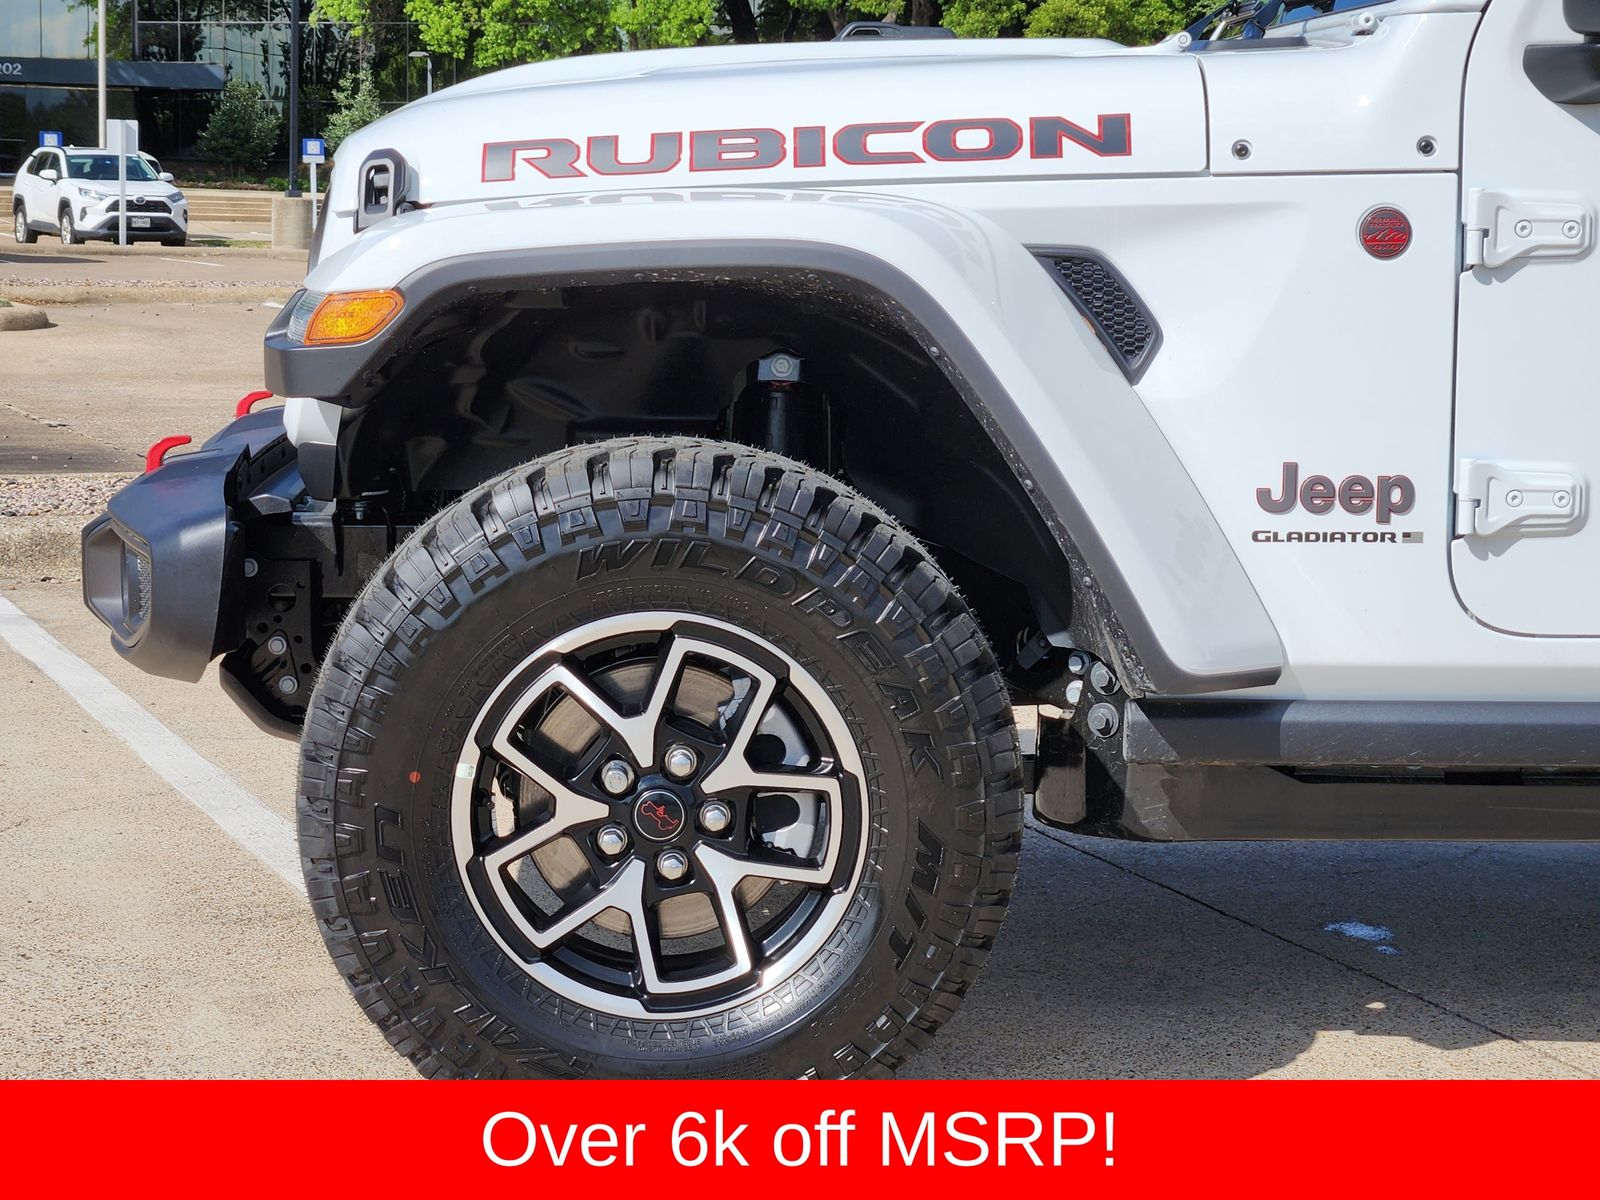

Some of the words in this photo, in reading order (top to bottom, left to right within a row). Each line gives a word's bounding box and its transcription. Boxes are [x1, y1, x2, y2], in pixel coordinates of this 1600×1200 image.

[0, 62, 22, 75] 02
[481, 113, 1132, 183] RUBICON
[1256, 461, 1416, 525] Jeep
[1251, 530, 1398, 544] GLADIATOR
